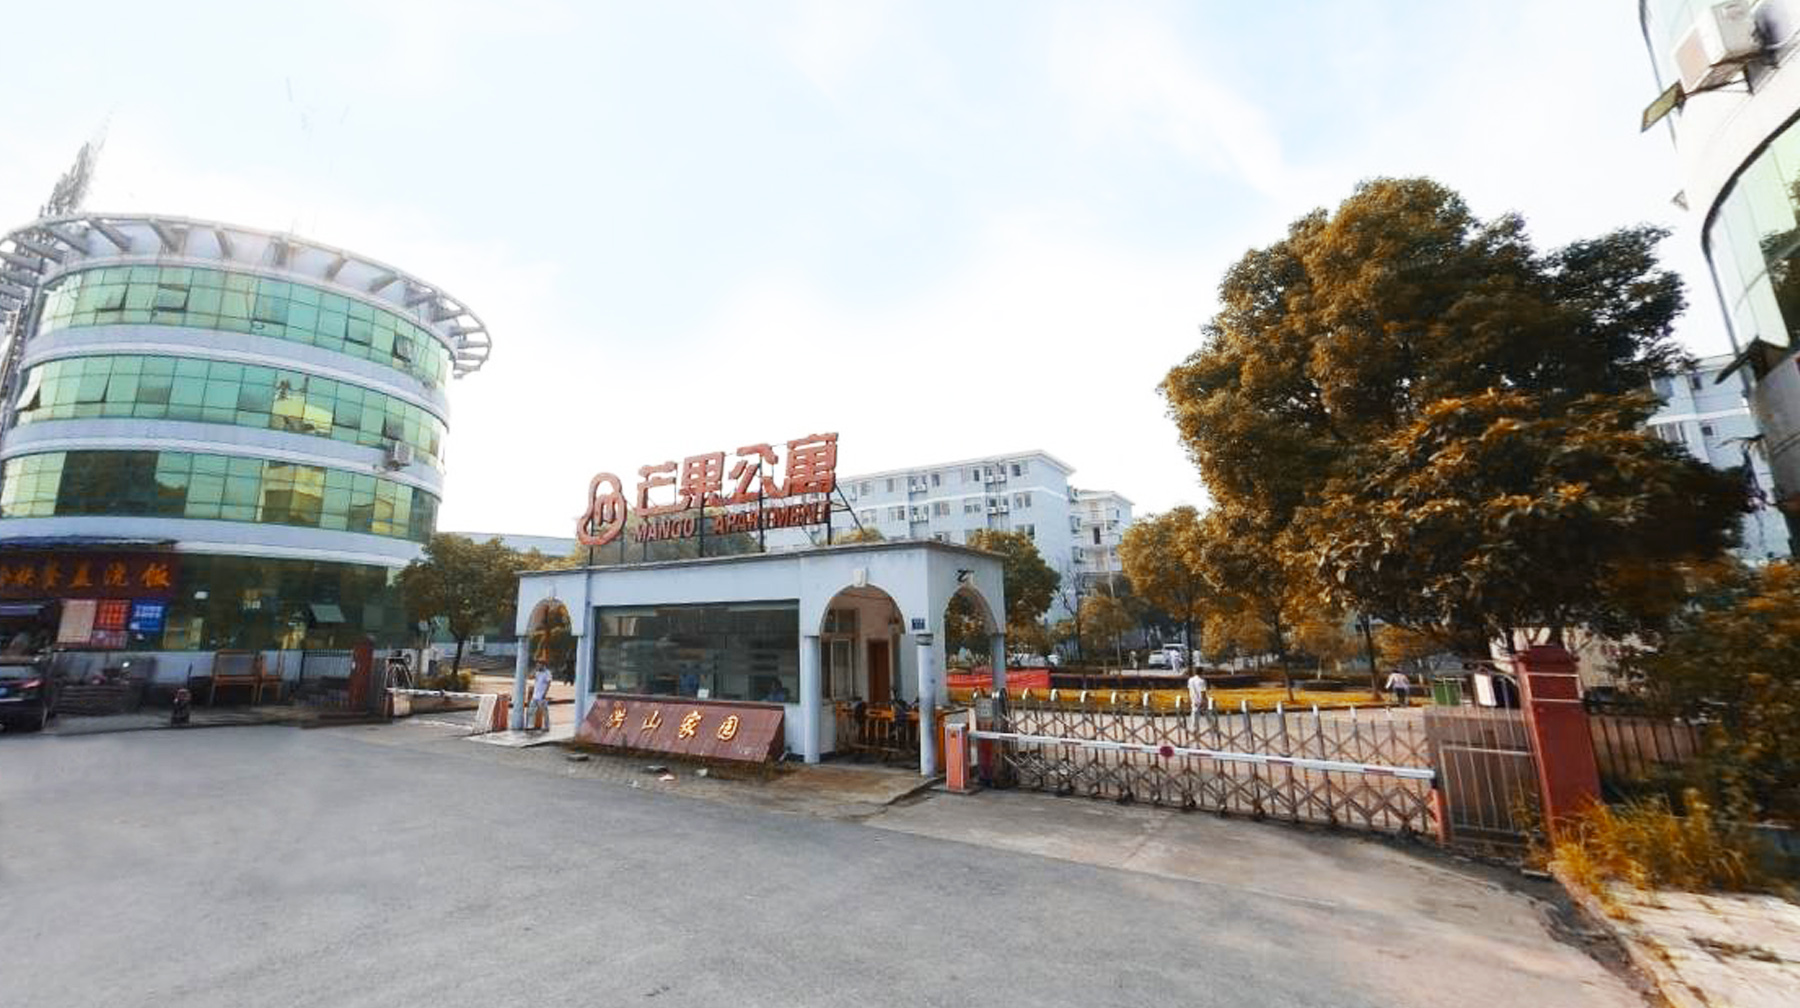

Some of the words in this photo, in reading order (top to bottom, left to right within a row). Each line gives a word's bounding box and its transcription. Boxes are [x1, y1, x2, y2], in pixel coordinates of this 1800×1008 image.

[637, 432, 838, 517] 芒果公寓
[634, 518, 696, 542] MANGO
[714, 501, 831, 536] APARTMENT
